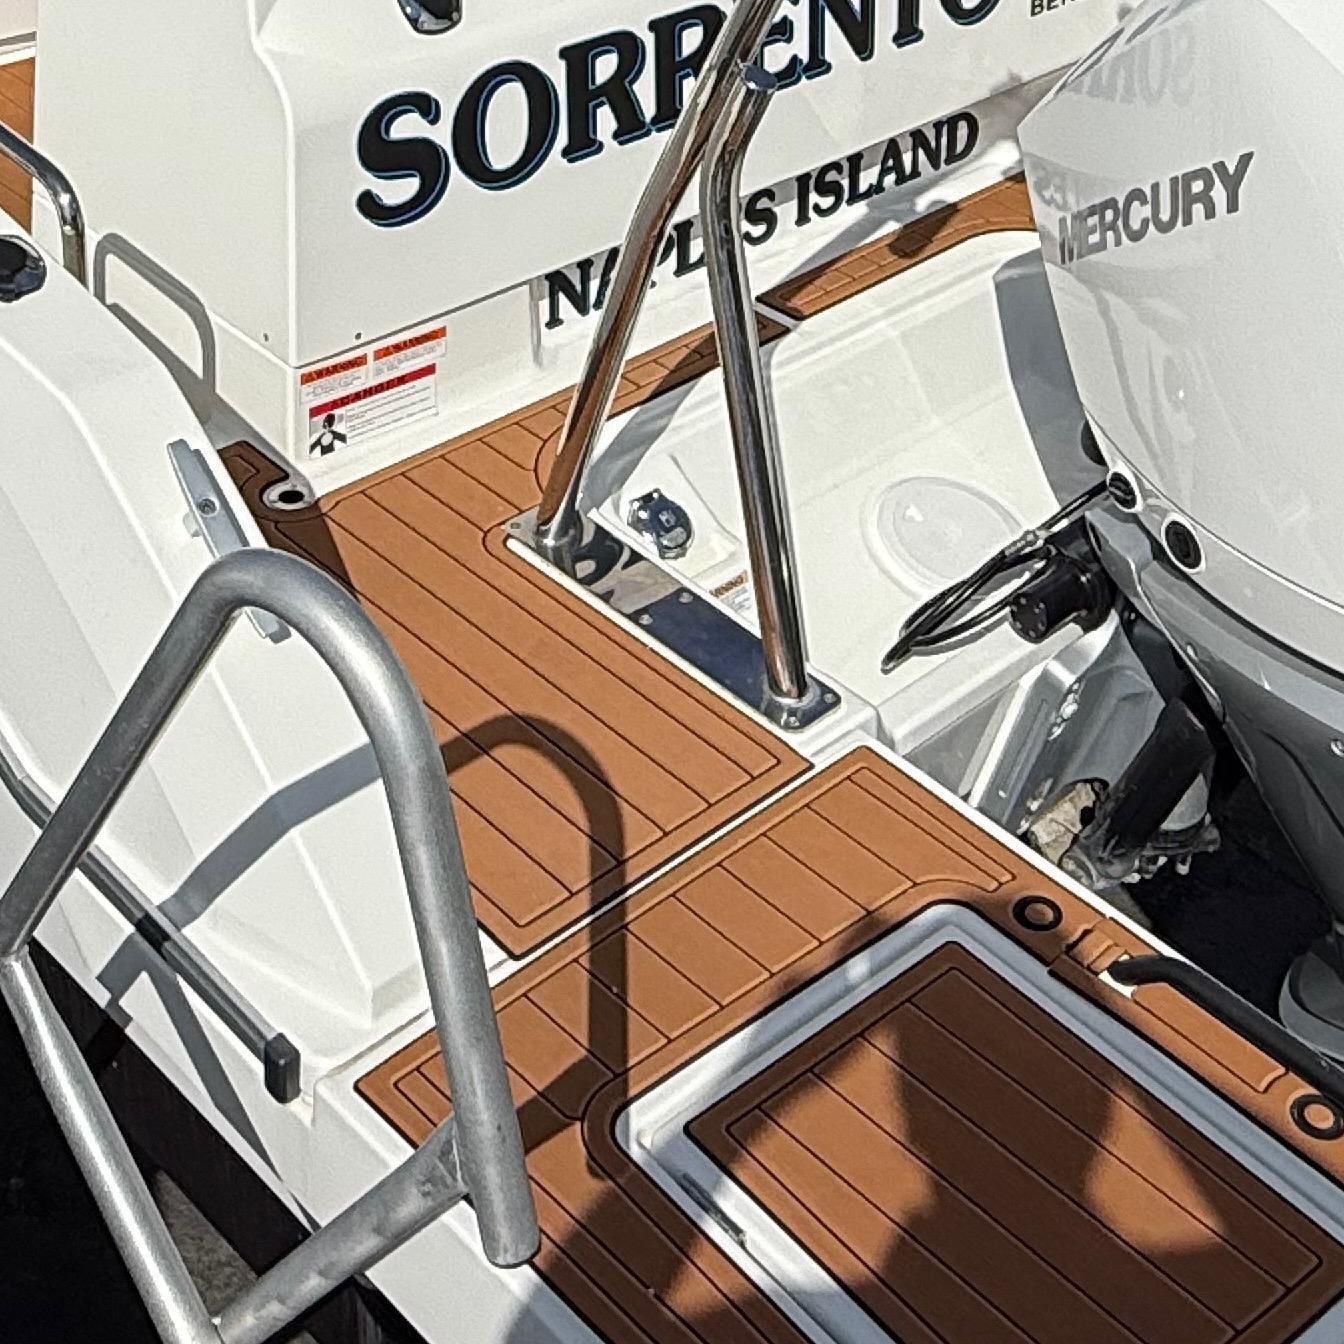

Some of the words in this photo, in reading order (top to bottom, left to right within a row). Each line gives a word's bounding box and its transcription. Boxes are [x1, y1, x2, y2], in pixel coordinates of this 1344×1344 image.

[545, 188, 778, 330] NLS
[794, 111, 980, 227] ISLAND
[1058, 150, 1255, 265] MERCURY
